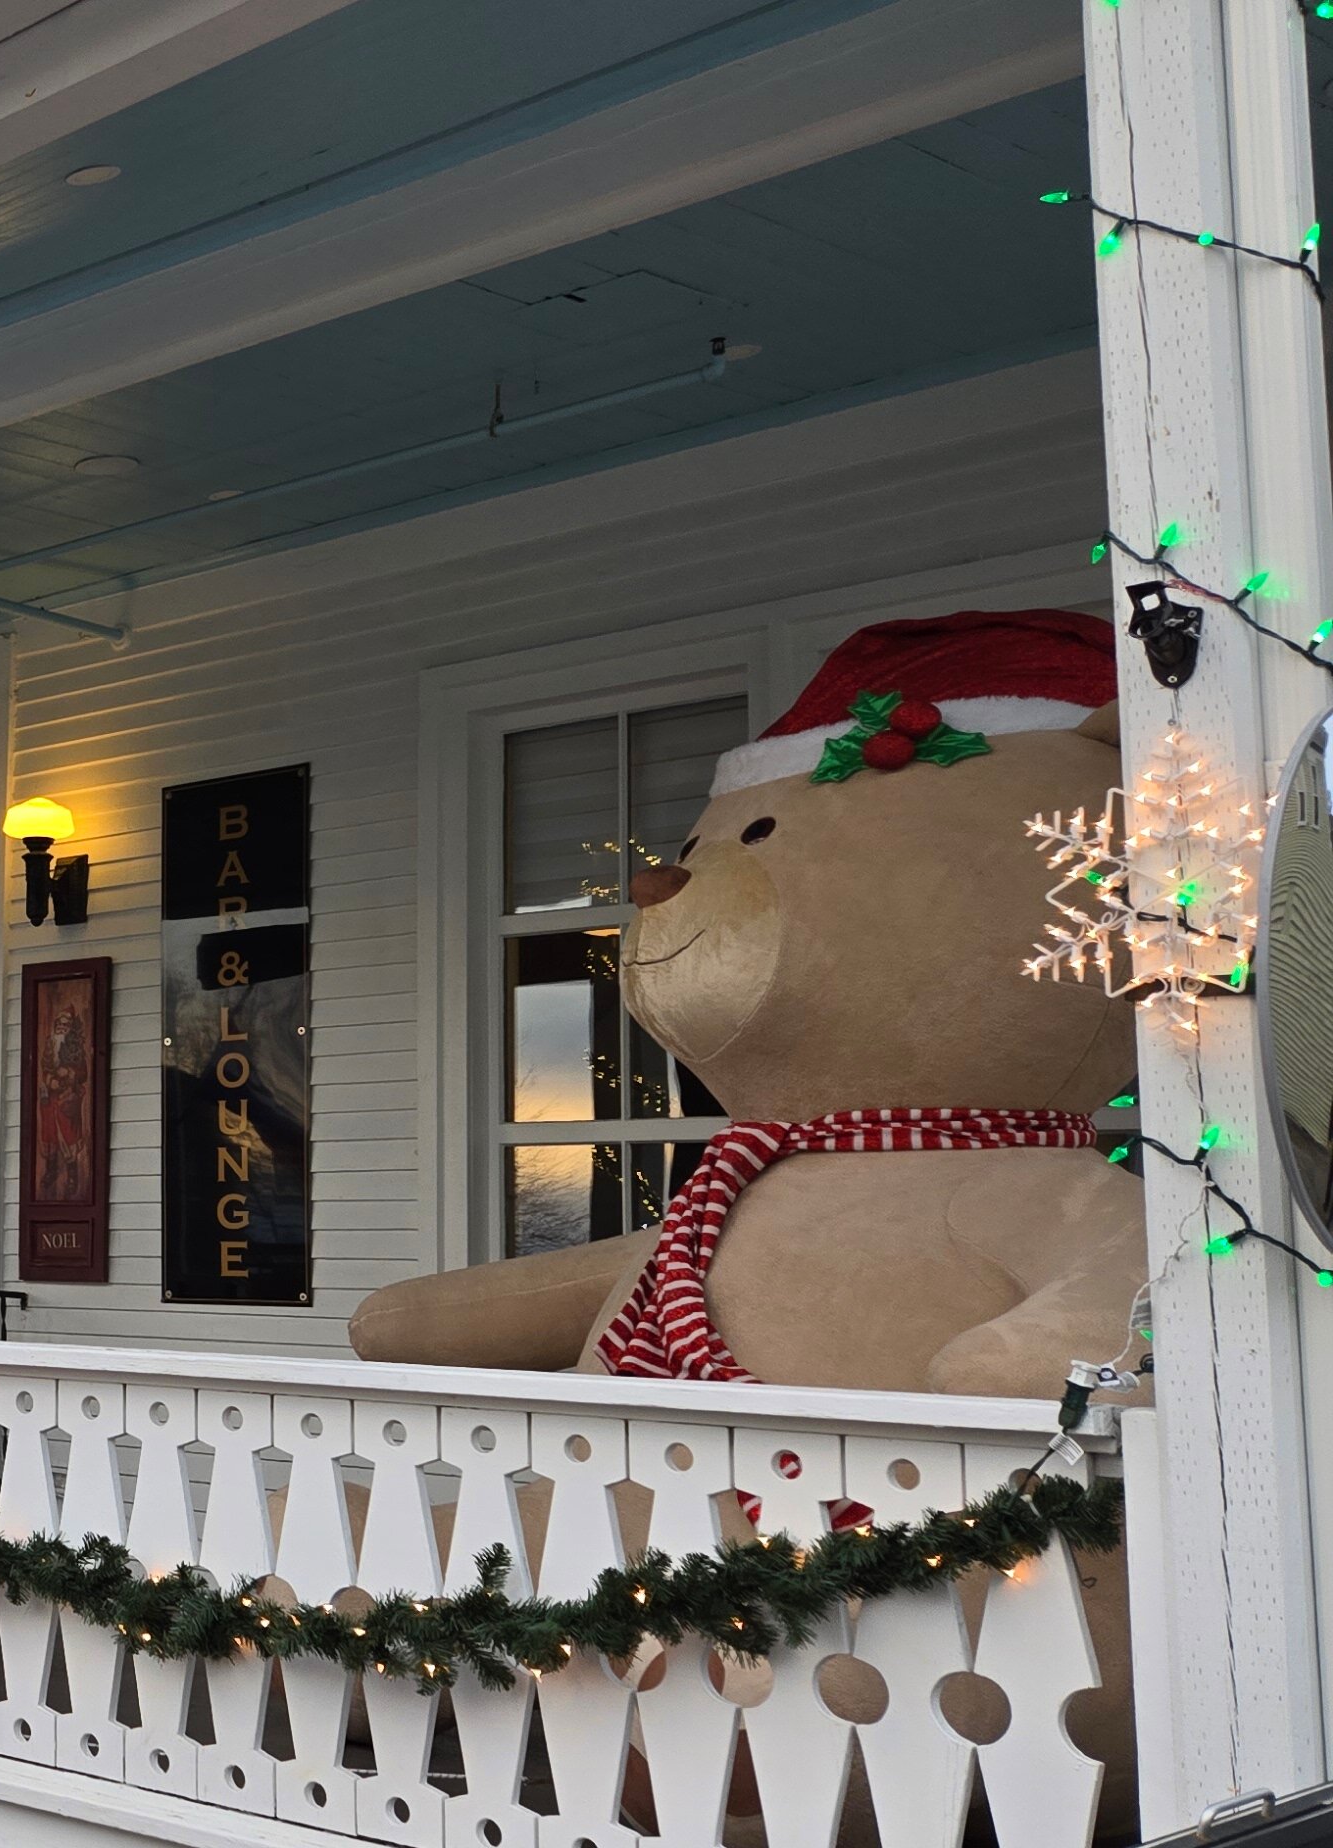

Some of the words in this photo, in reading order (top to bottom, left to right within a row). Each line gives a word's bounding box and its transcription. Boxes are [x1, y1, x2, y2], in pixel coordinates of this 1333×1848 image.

[215, 803, 250, 930] BAR
[217, 951, 250, 987] &
[216, 1007, 250, 1279] LOUNGE
[41, 1232, 82, 1250] NOEL
